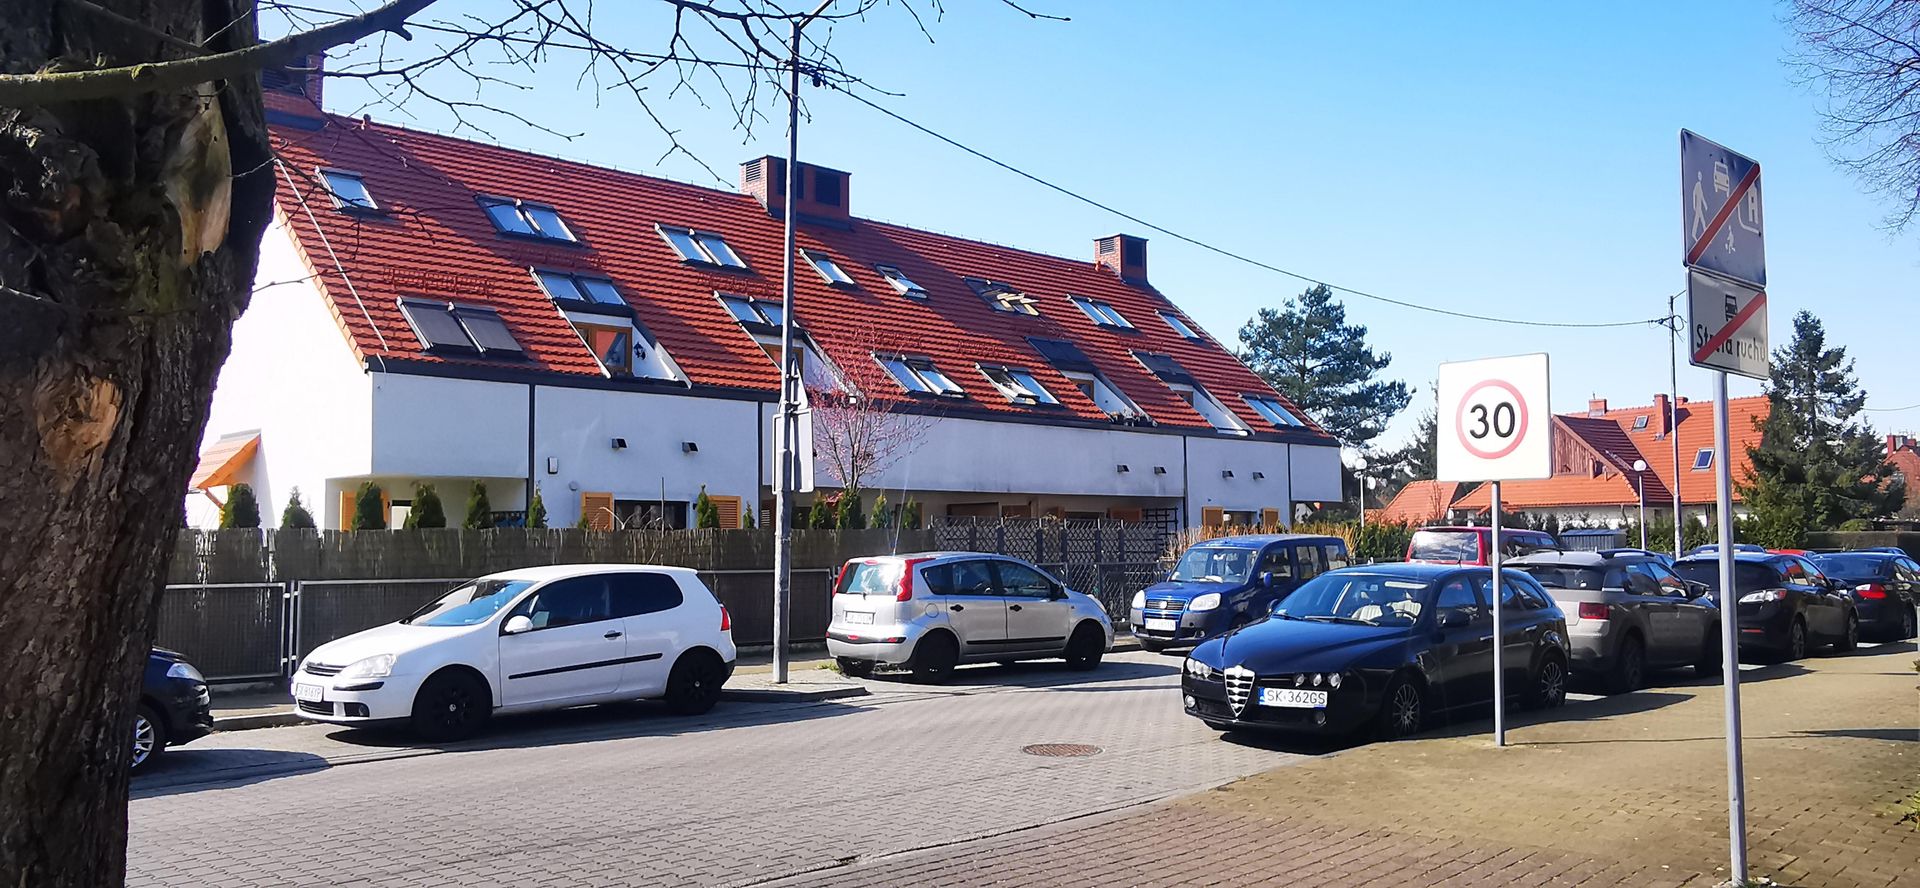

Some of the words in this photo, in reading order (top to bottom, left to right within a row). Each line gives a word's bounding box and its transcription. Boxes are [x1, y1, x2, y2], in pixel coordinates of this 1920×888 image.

[1736, 337, 1766, 362] ruchu
[1469, 401, 1516, 439] 30
[1267, 689, 1283, 702] SK
[1288, 691, 1326, 704] 362GS
